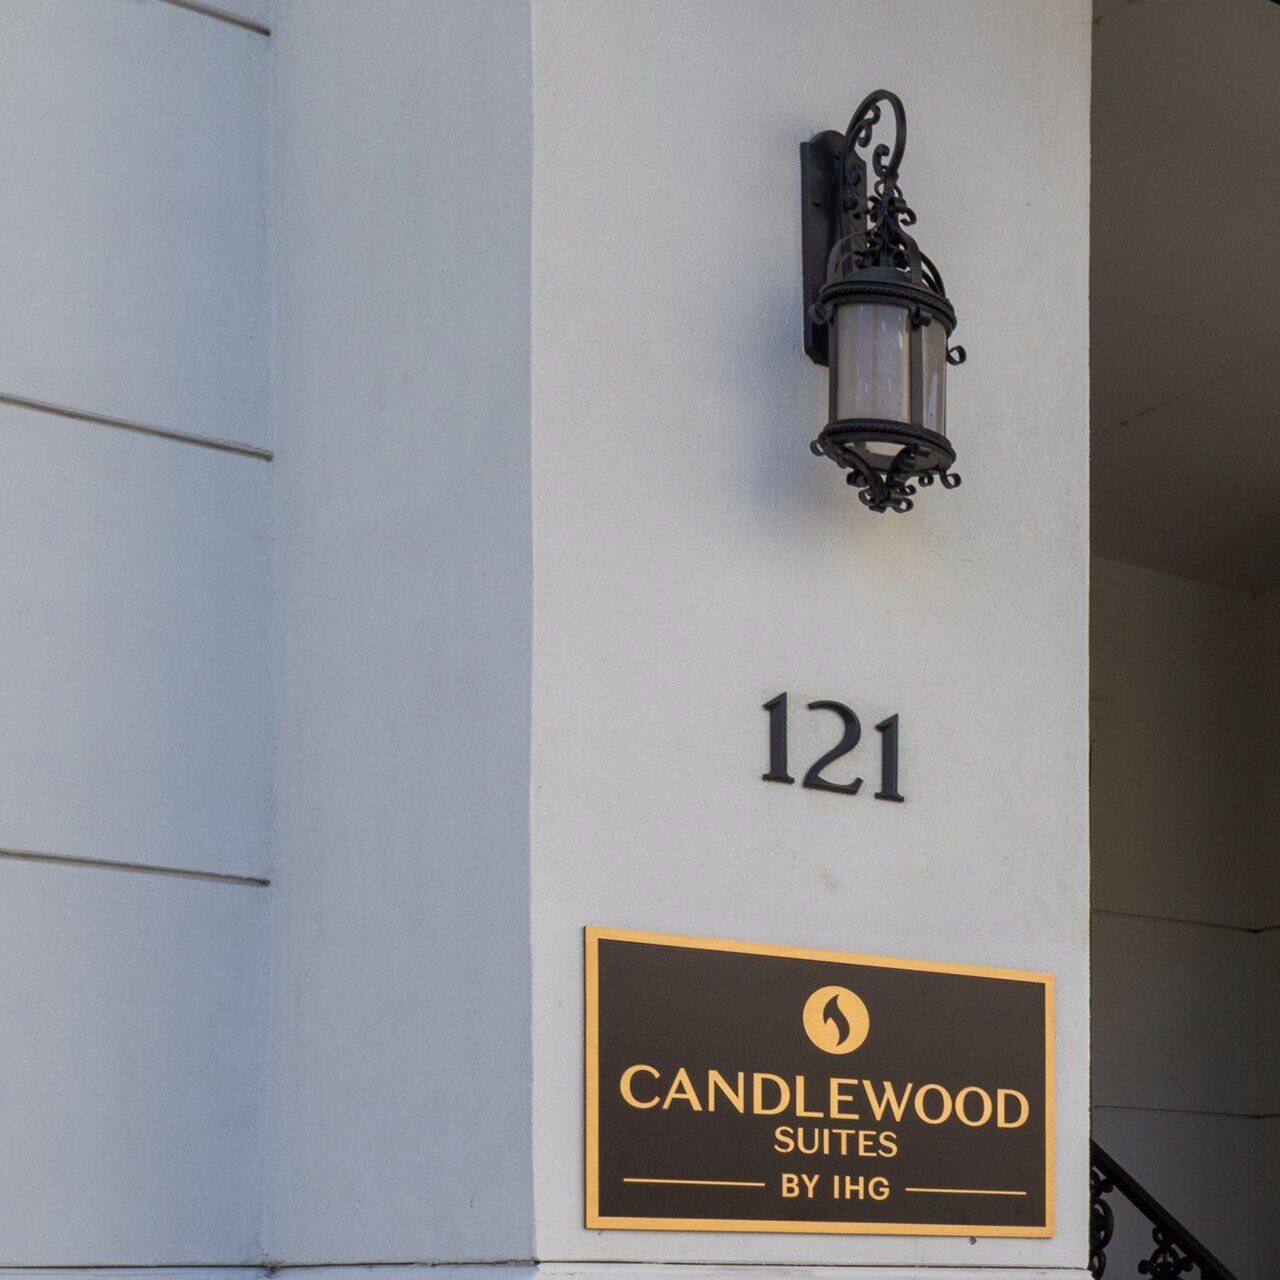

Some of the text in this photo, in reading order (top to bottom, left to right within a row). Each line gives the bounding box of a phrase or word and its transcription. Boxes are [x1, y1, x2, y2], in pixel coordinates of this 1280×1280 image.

[761, 691, 905, 803] 121
[619, 1063, 1030, 1129] CANDLEWOOD
[773, 1125, 899, 1158] SUITES
[781, 1173, 891, 1201] BY IHG
